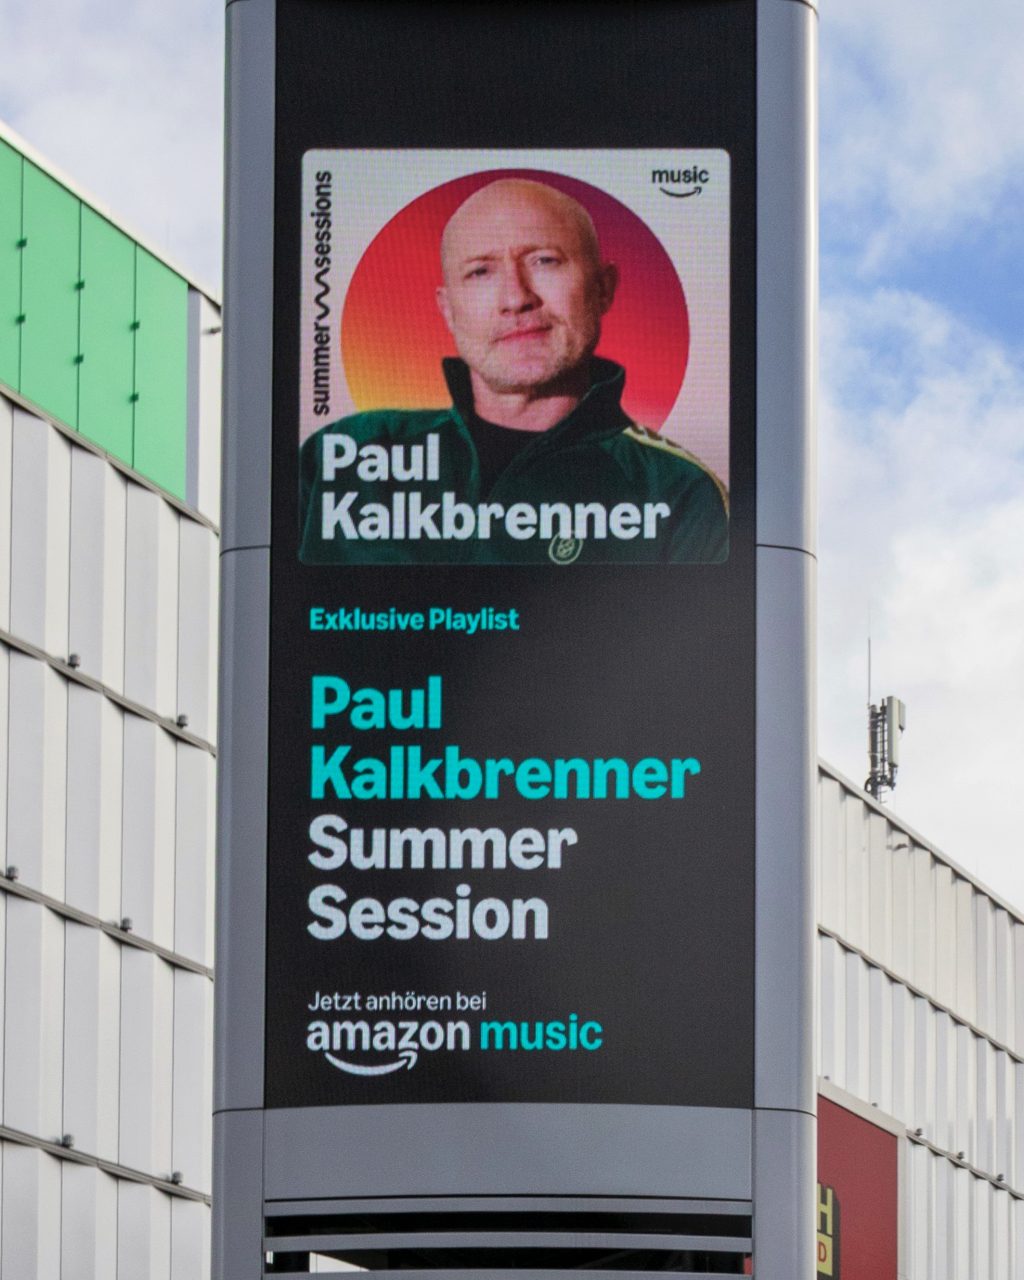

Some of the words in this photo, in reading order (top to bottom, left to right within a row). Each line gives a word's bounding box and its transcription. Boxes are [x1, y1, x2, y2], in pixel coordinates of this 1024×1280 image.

[652, 167, 709, 184] music
[310, 170, 332, 269] sessions
[313, 319, 331, 416] summer
[321, 434, 439, 480] Paul
[321, 492, 670, 539] Kalkbrenner
[309, 608, 425, 631] Exklusive
[429, 607, 520, 635] Playlist
[311, 676, 442, 729] Paul
[311, 746, 700, 800] Kalkbrenner
[307, 814, 578, 871] Summer
[307, 884, 549, 941] Session
[308, 992, 362, 1012] Jetzt
[365, 992, 452, 1012] anhören
[456, 991, 487, 1011] bei
[307, 1020, 471, 1052] amazon
[480, 1013, 603, 1051] music
